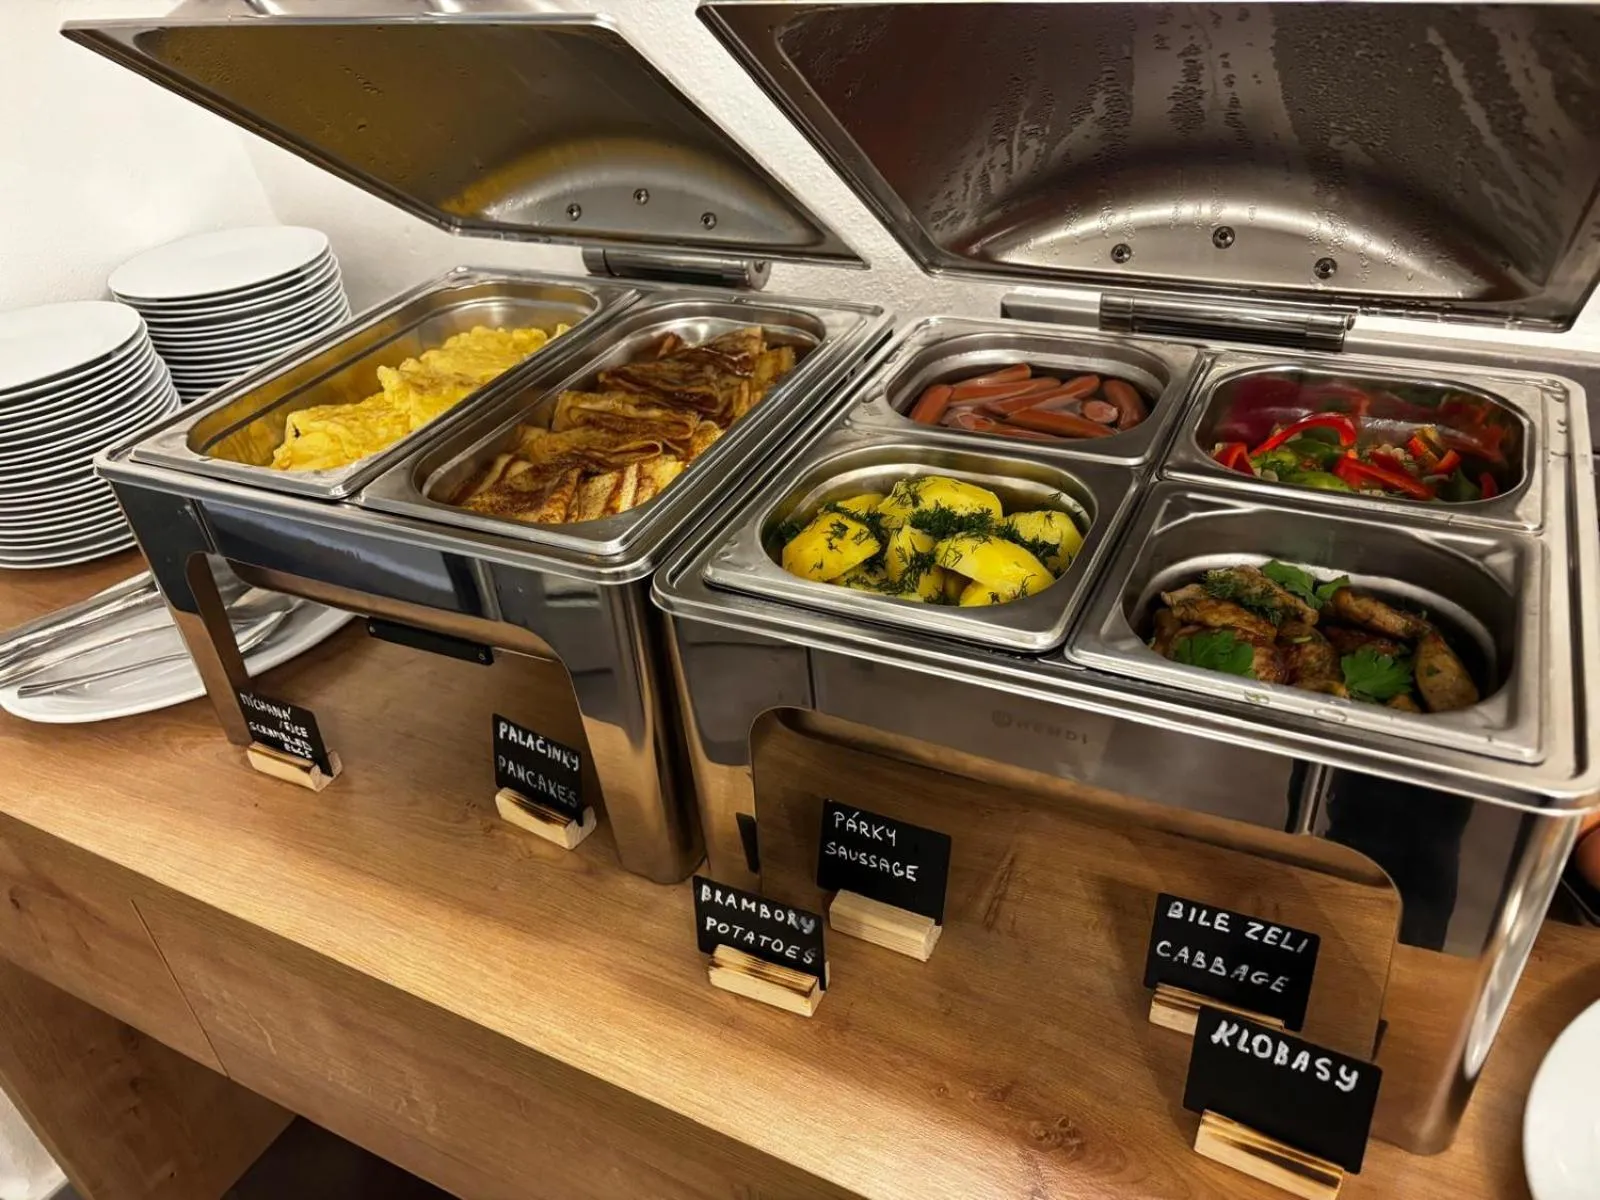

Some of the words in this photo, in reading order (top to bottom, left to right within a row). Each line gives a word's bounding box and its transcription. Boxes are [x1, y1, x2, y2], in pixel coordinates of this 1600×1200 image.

[499, 721, 579, 771] PALAČINKY
[498, 755, 577, 807] PANCAKES
[833, 811, 896, 846] PÁRKY
[825, 842, 919, 881] SAUSSAGE
[701, 884, 815, 934] BRAMBORY
[1167, 901, 1230, 932] BILE
[1244, 921, 1309, 953] ZELI
[706, 916, 816, 964] POTATOES
[1156, 940, 1289, 993] CABBAGE
[1211, 1020, 1358, 1092] KLOBASY
